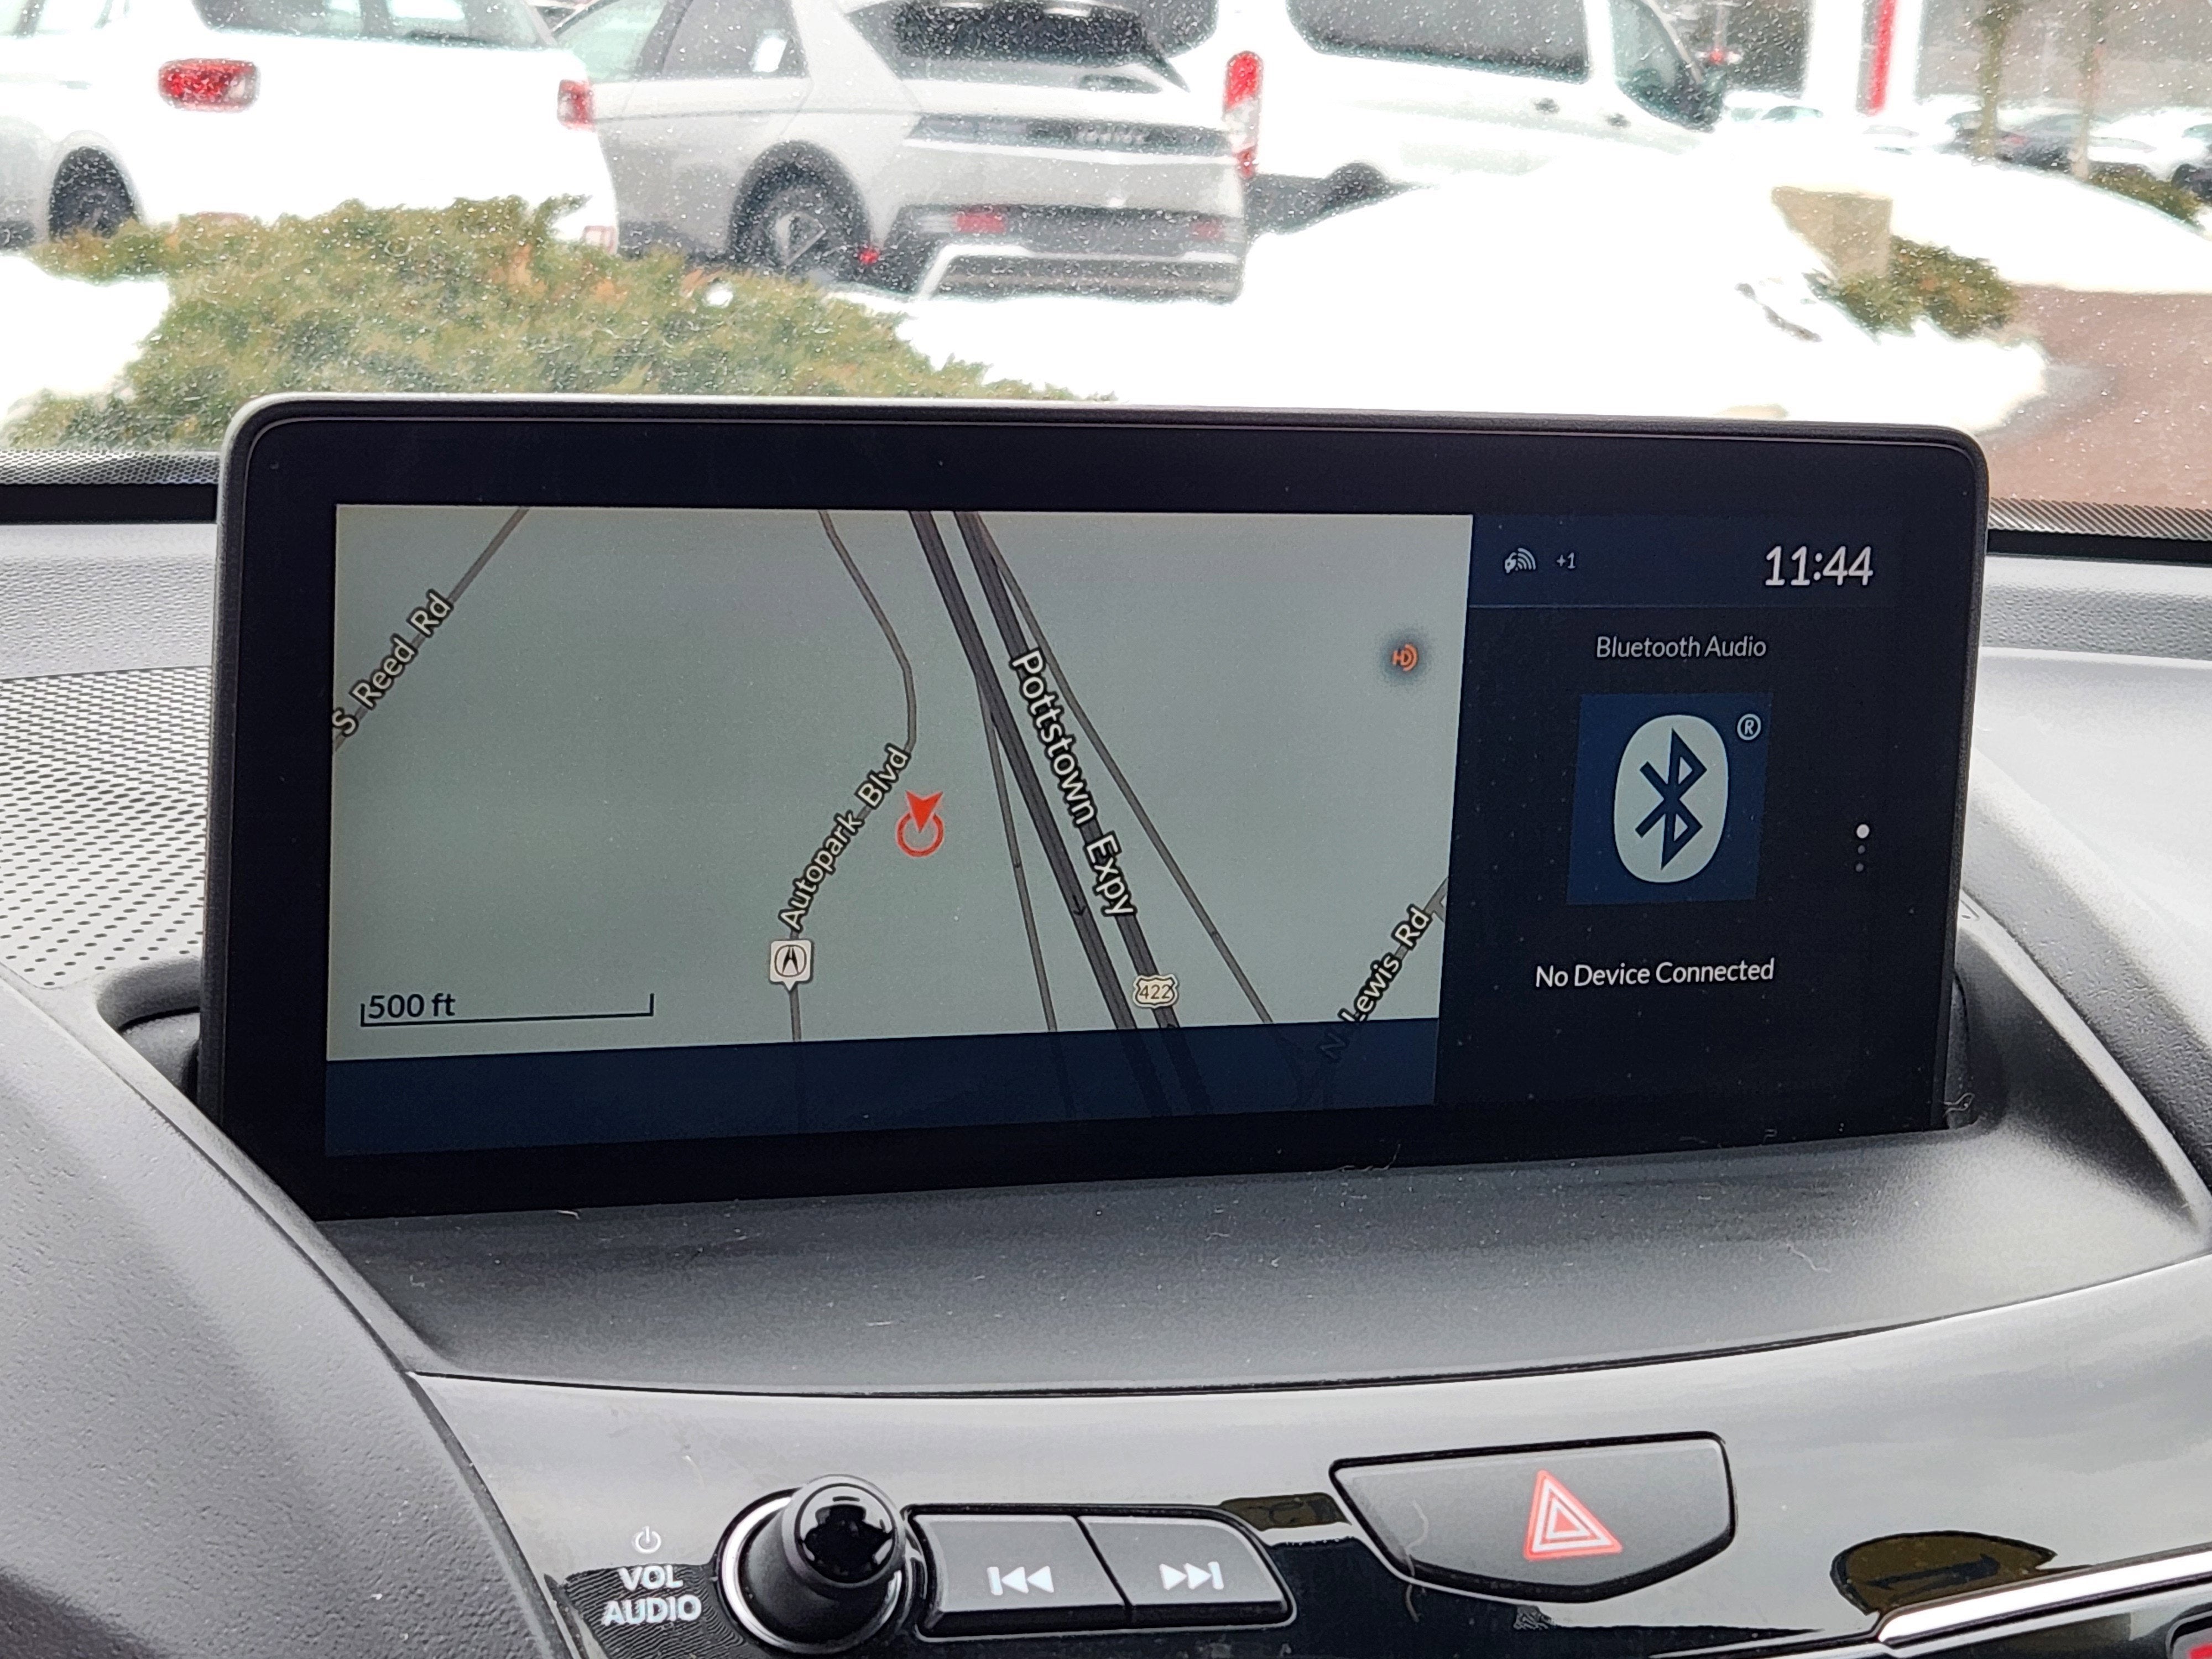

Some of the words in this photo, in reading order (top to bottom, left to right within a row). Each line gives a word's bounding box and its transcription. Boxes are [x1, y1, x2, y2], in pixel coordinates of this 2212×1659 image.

[1556, 552, 1576, 570] +1
[1764, 545, 1875, 586] 11:44
[1596, 635, 1700, 658] Bluetooth
[1704, 635, 1767, 658] Audio
[332, 710, 357, 735] S
[352, 637, 416, 708] Reed
[410, 592, 452, 635] Rd
[1011, 650, 1095, 824] Pottstown
[1086, 834, 1134, 914] Expy
[780, 811, 863, 931] Autopark
[858, 746, 909, 807] Blvd
[1341, 955, 1400, 1022] Lewis
[1394, 906, 1430, 947] Rd
[1535, 965, 1569, 988] No
[1574, 962, 1651, 987] Device
[1655, 957, 1776, 983] Connected
[368, 993, 425, 1019] 500
[431, 993, 456, 1017] ft
[1139, 984, 1171, 1000] 422
[618, 1564, 684, 1592] VOL
[601, 1594, 702, 1627] AUDIO
